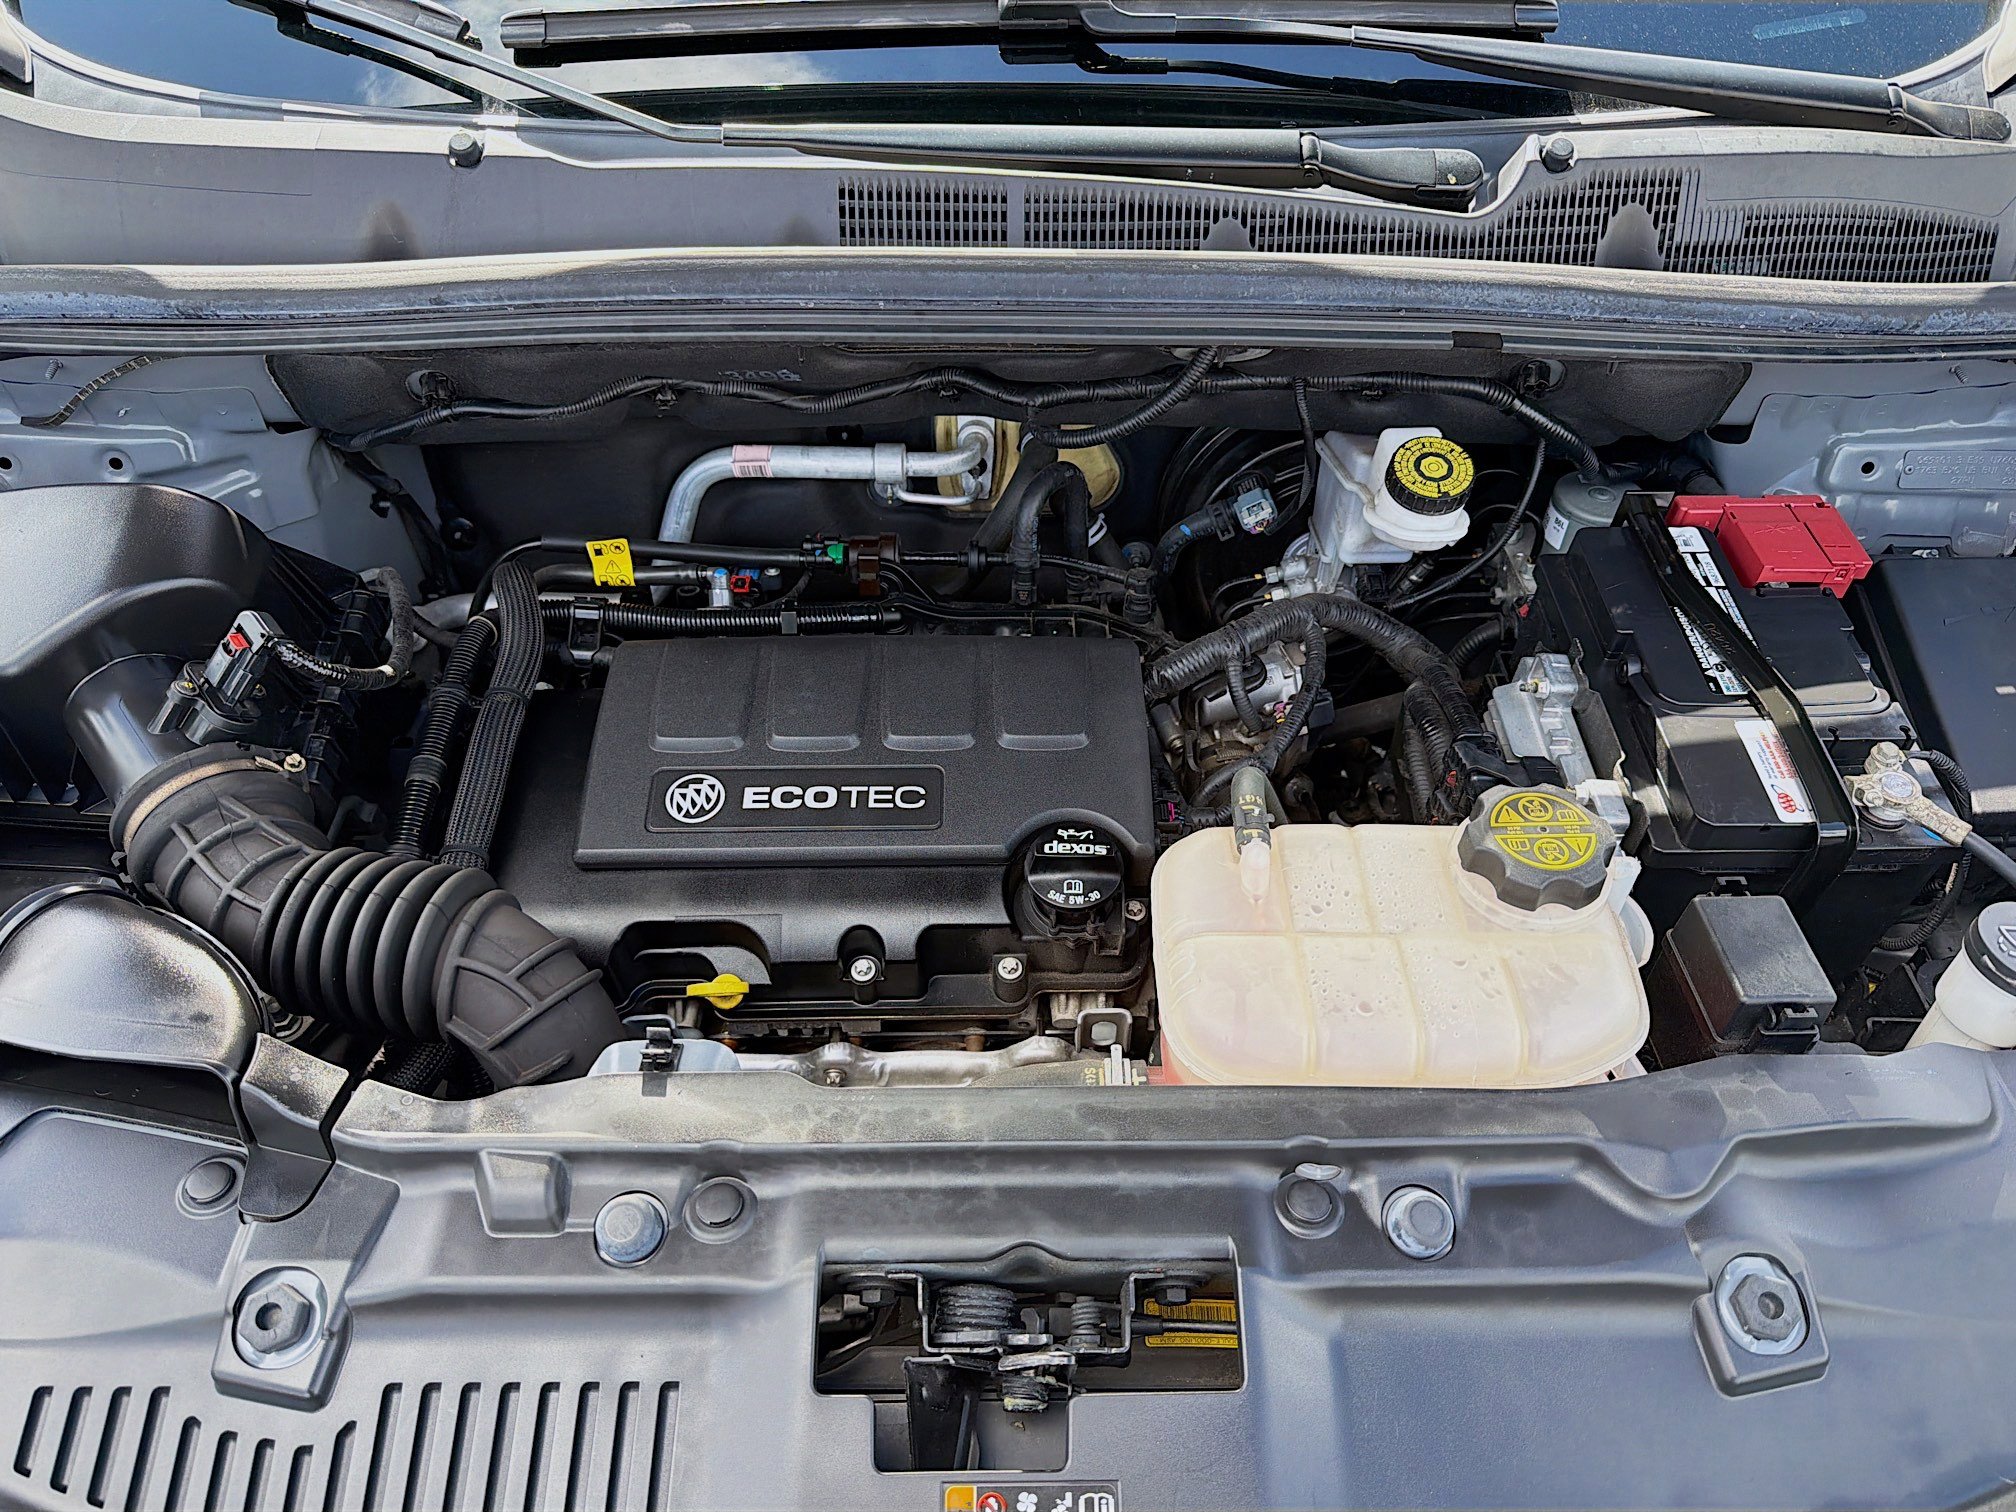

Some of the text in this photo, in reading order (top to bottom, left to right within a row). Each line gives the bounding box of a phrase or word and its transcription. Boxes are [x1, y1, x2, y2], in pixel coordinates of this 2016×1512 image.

[742, 785, 926, 810] ECOTEC
[1043, 840, 1108, 856] dexos
[1047, 889, 1101, 905] SAE 5W-30
